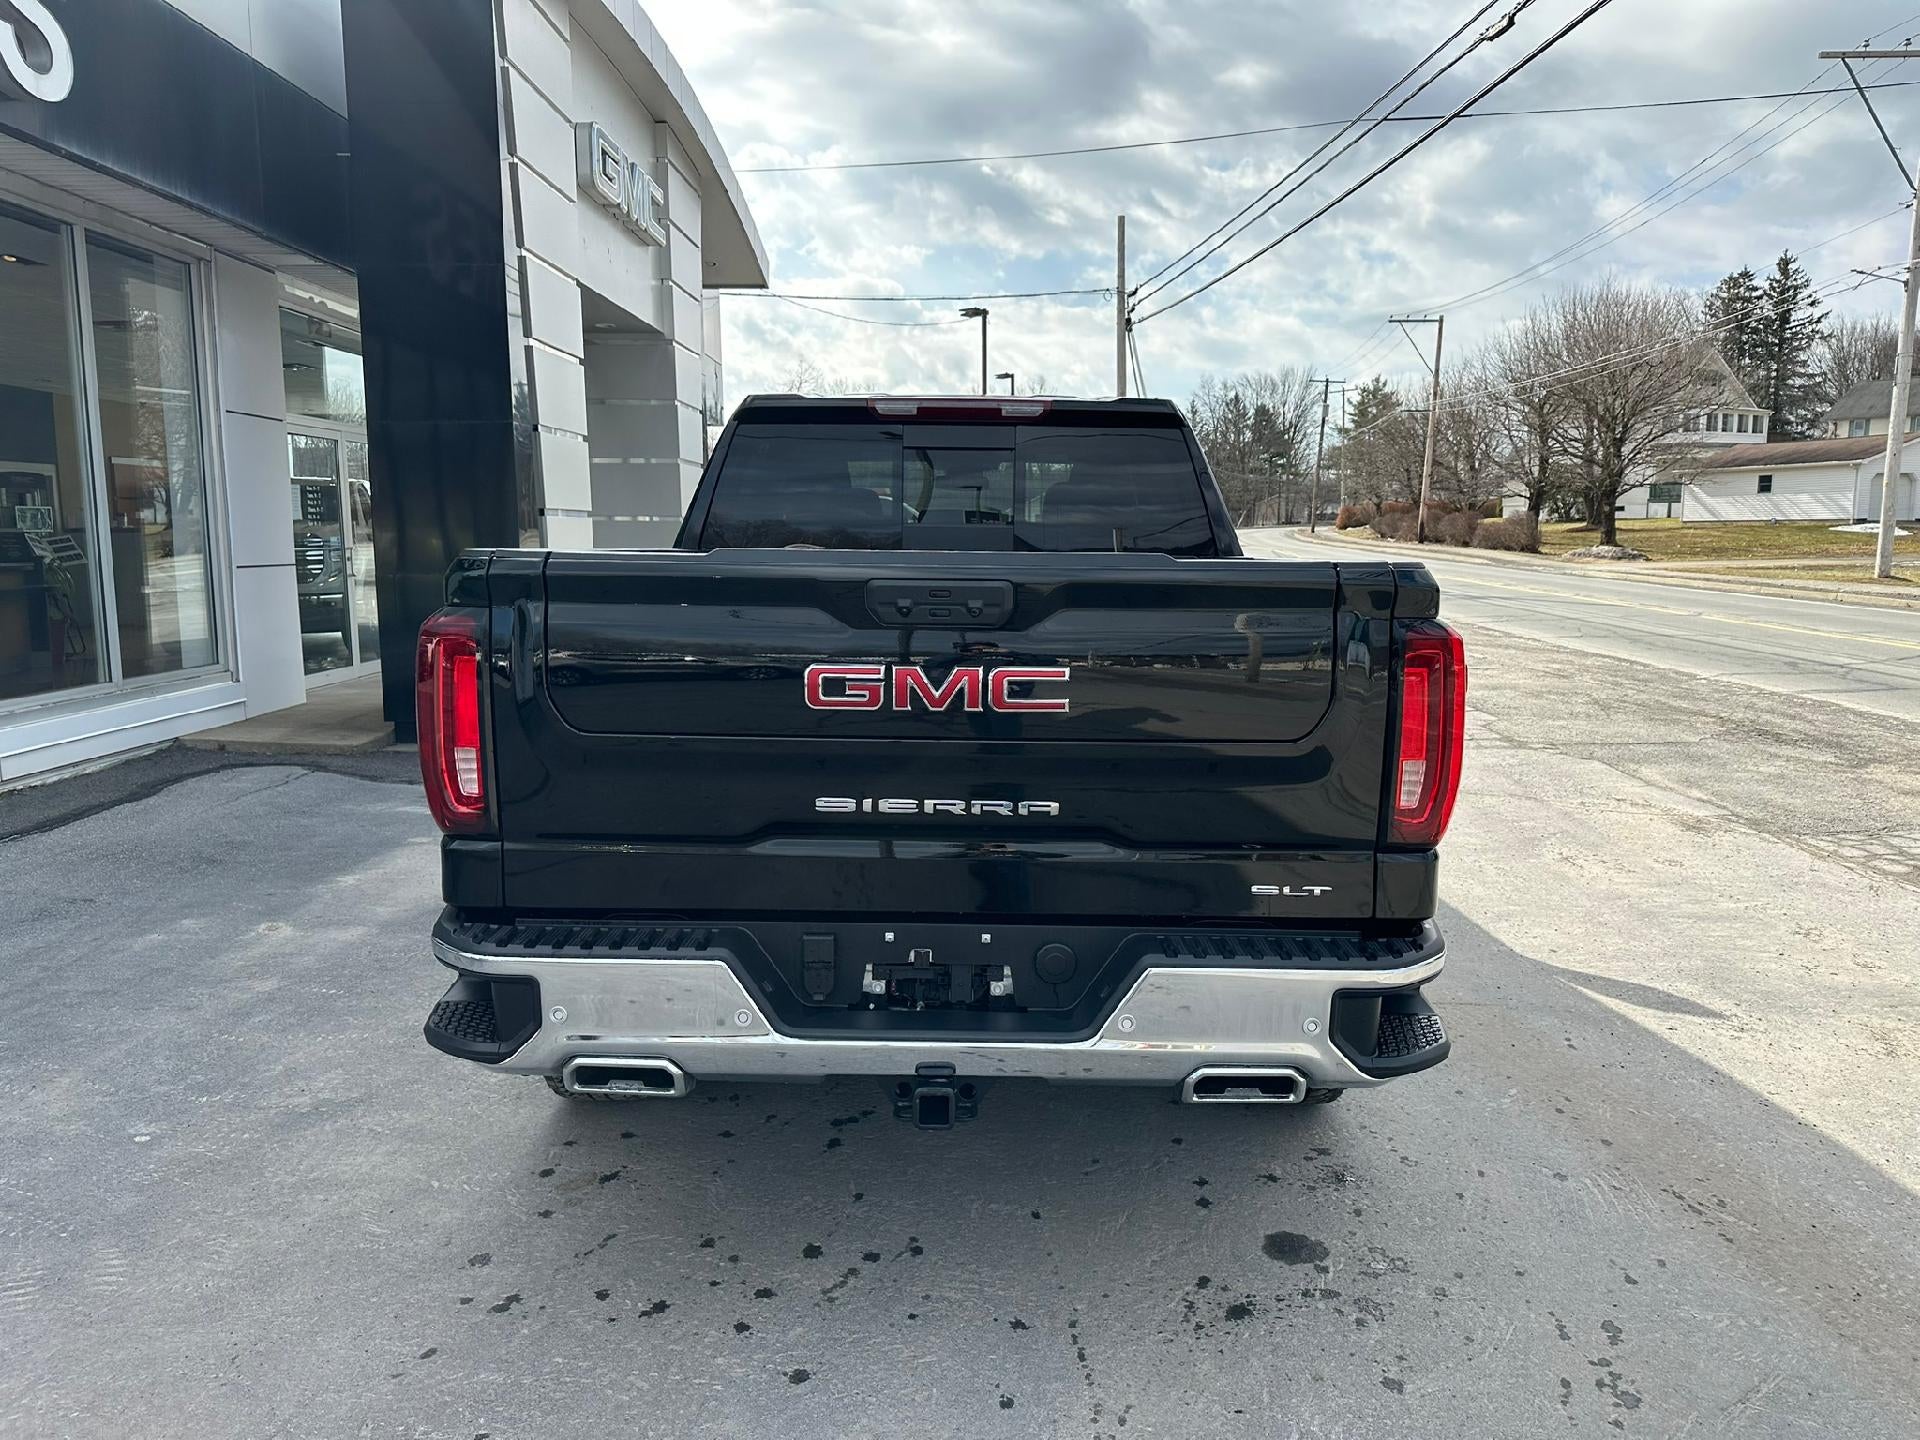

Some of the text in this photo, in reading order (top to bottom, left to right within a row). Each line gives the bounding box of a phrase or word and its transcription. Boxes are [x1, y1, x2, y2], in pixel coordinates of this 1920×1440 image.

[588, 121, 667, 247] GMC
[804, 663, 1071, 713] GMC
[815, 797, 1060, 816] SIERRA
[1251, 885, 1333, 897] SLT
